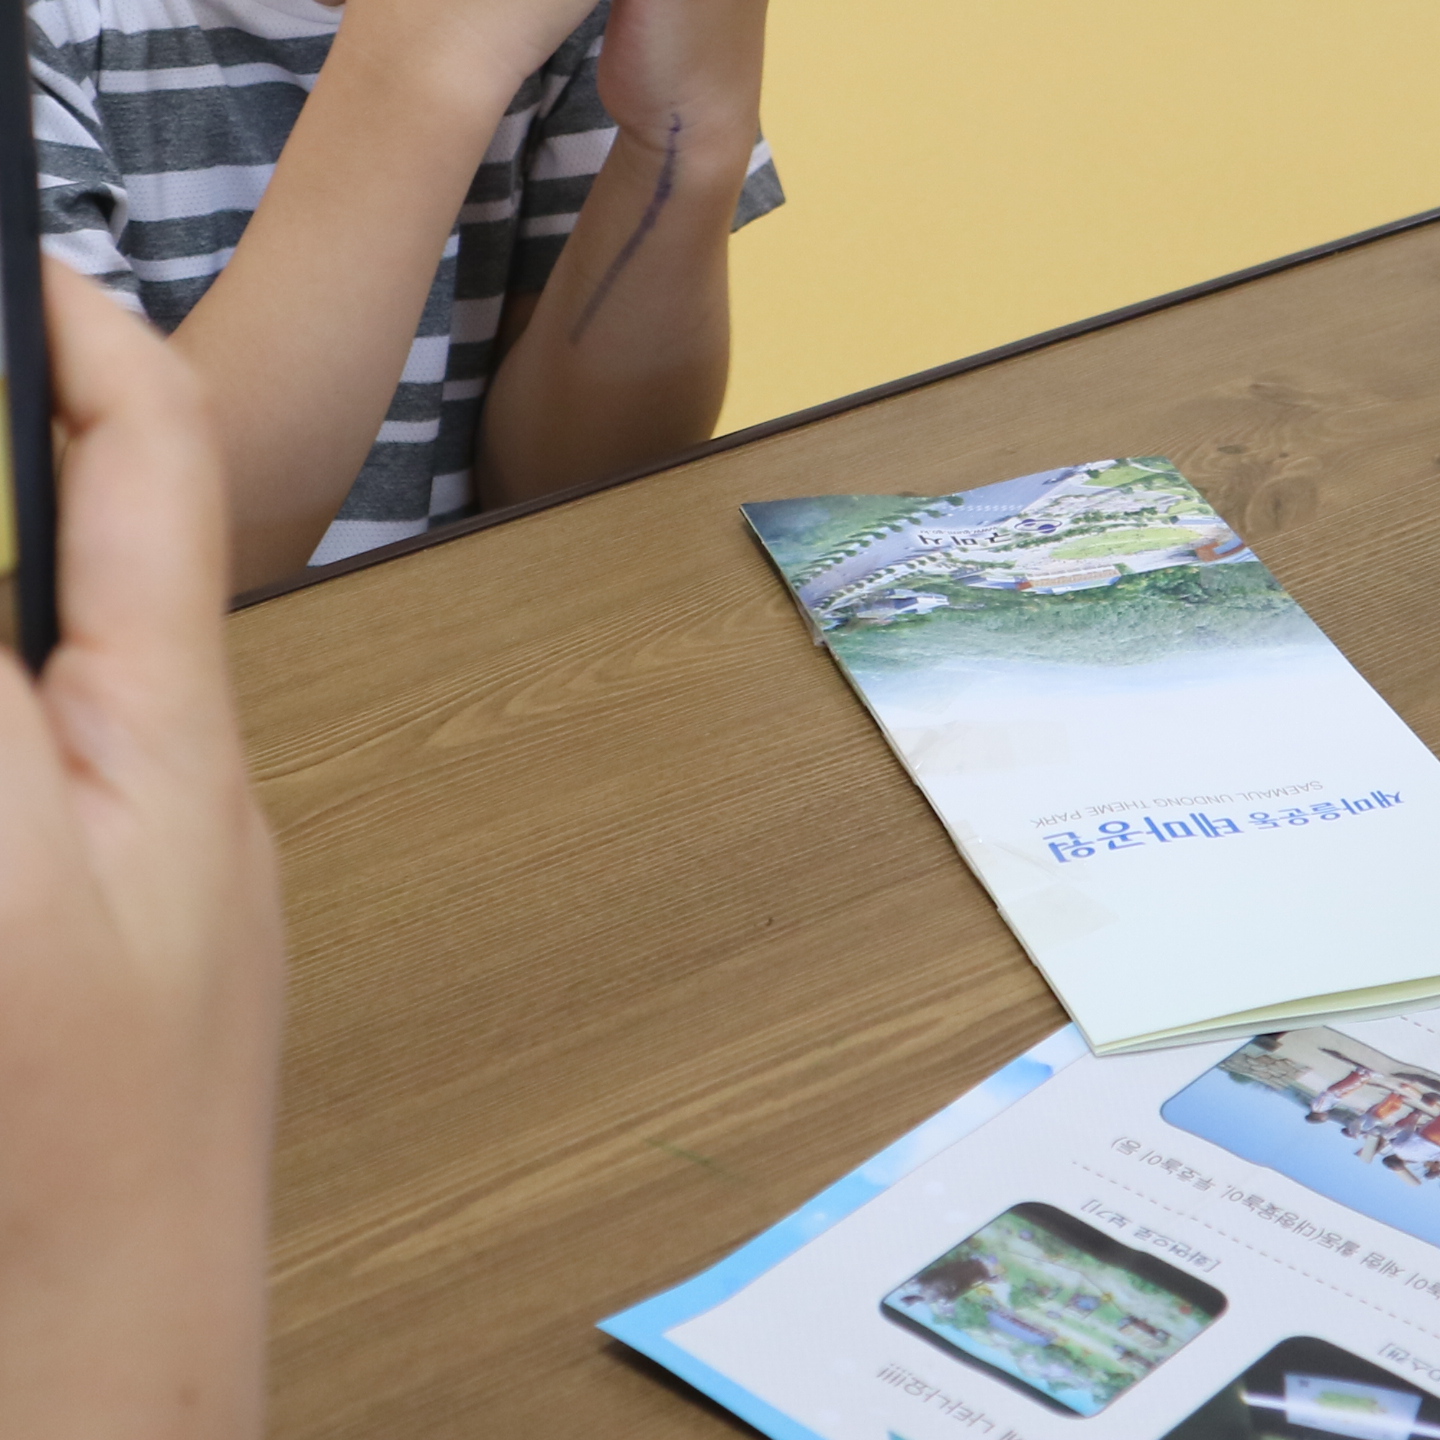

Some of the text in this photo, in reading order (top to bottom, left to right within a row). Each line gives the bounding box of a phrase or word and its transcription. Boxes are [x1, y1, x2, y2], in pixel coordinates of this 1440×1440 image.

[917, 531, 1013, 547] 구미시
[1029, 778, 1323, 830] SAEMAUL UNDONG THEME PARK
[1040, 788, 1402, 865] 새마을운동 테마공원
[1110, 1134, 1142, 1157] 등)
[1139, 1148, 1216, 1192] 투호놀이
[1080, 1197, 1222, 1274] [화면으로 보기]
[1359, 1250, 1406, 1278] 체험
[875, 1362, 998, 1434] 나타나요!!!!
